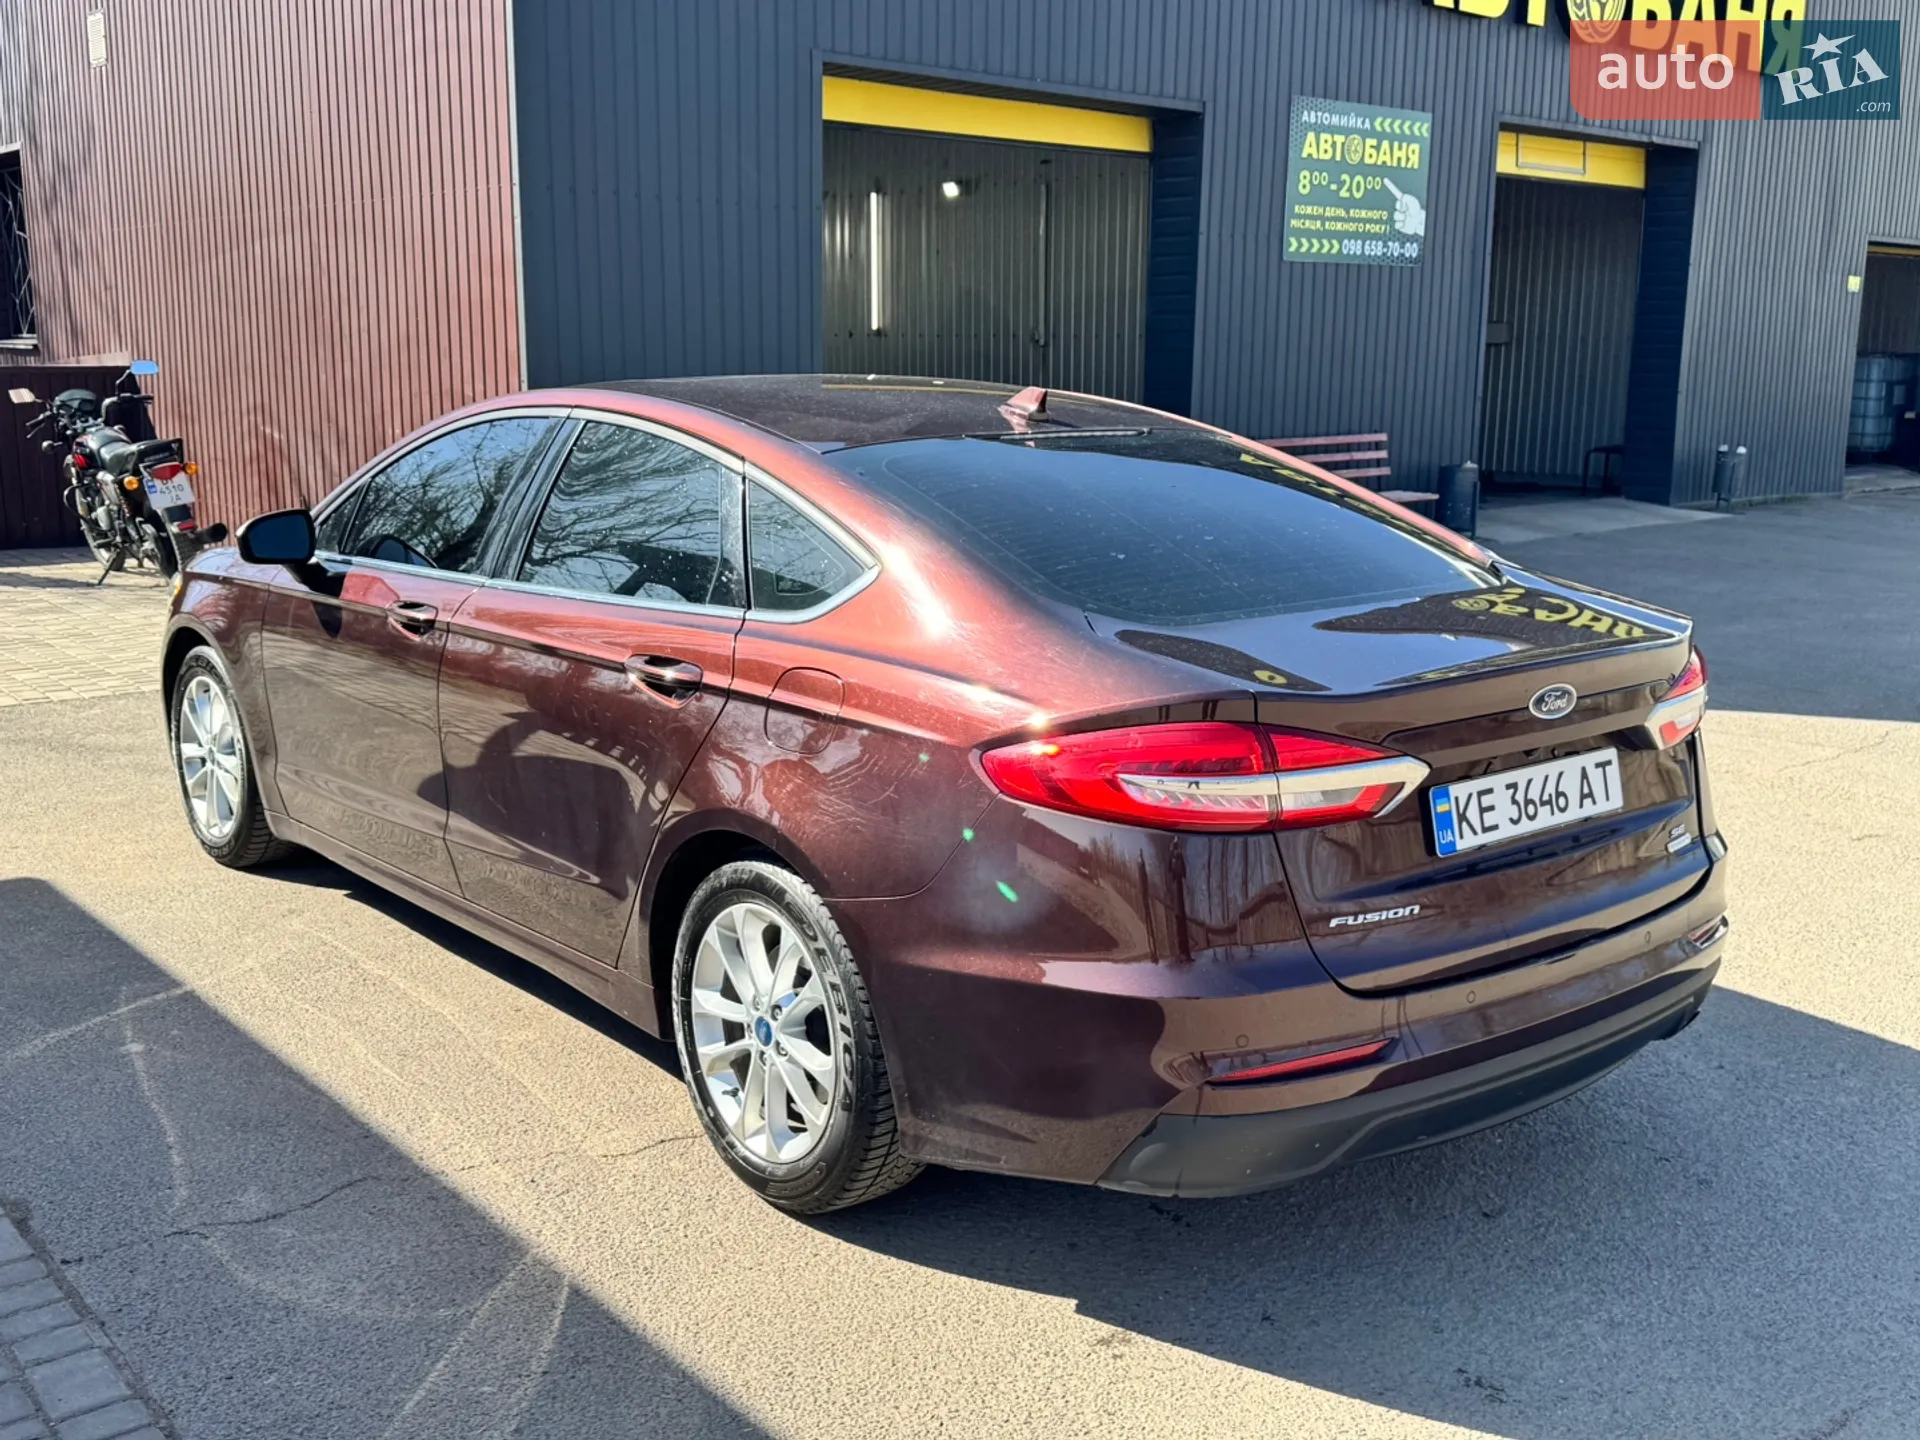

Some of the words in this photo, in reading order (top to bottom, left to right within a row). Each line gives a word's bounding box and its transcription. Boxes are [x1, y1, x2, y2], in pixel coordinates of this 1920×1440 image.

[1433, 0, 1807, 77] БАНЯ
[1301, 110, 1371, 131] АВТОМИЙКА
[1301, 131, 1420, 169] АВТОБАНЯ
[1294, 204, 1324, 216] КОЖЕН
[1325, 206, 1348, 219] ДЕНЬ,
[1349, 207, 1388, 220] КОЖНОГО
[1325, 219, 1364, 232] КОЖНОГО
[1341, 239, 1363, 255] 098
[1364, 240, 1418, 258] 658-70-00
[1541, 691, 1568, 711] Ford
[1439, 830, 1454, 844] UA
[1454, 787, 1499, 840] KE
[1504, 771, 1569, 826] 3646
[1579, 760, 1613, 809] AT
